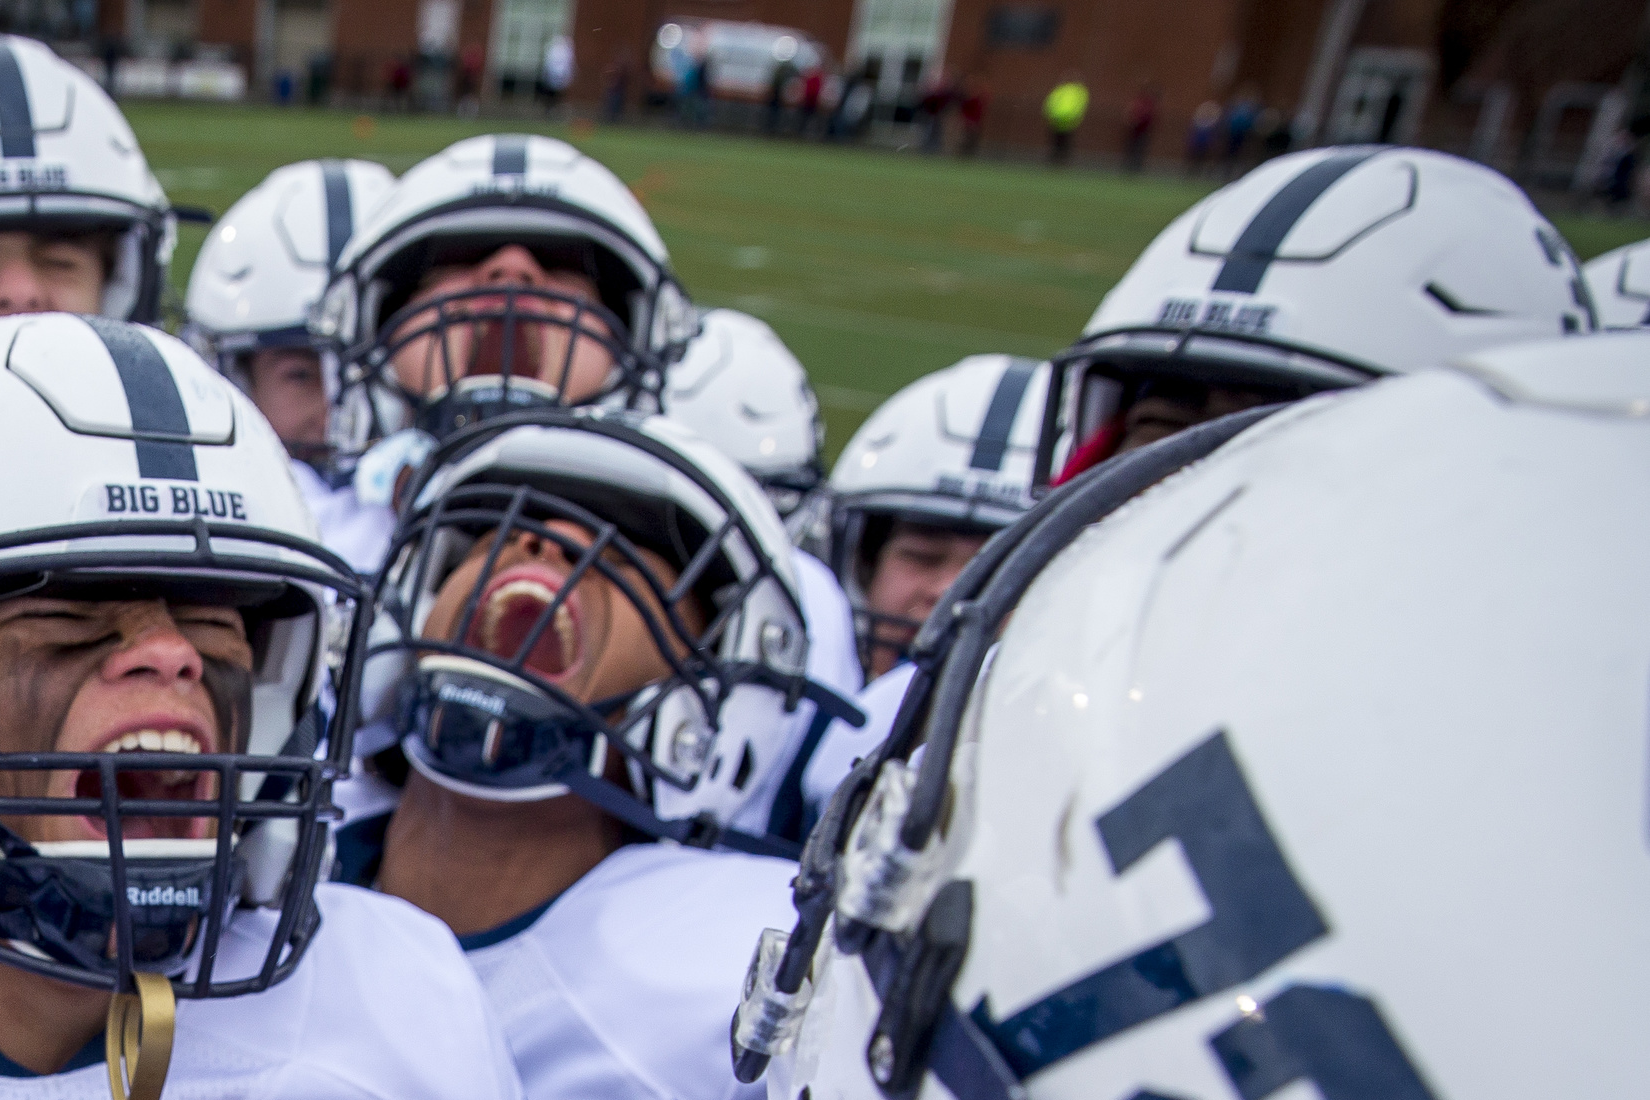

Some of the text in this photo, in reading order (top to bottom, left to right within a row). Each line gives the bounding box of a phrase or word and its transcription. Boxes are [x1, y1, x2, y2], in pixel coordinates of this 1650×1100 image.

[105, 483, 247, 521] BIG BLUE
[126, 885, 200, 907] Riddell
